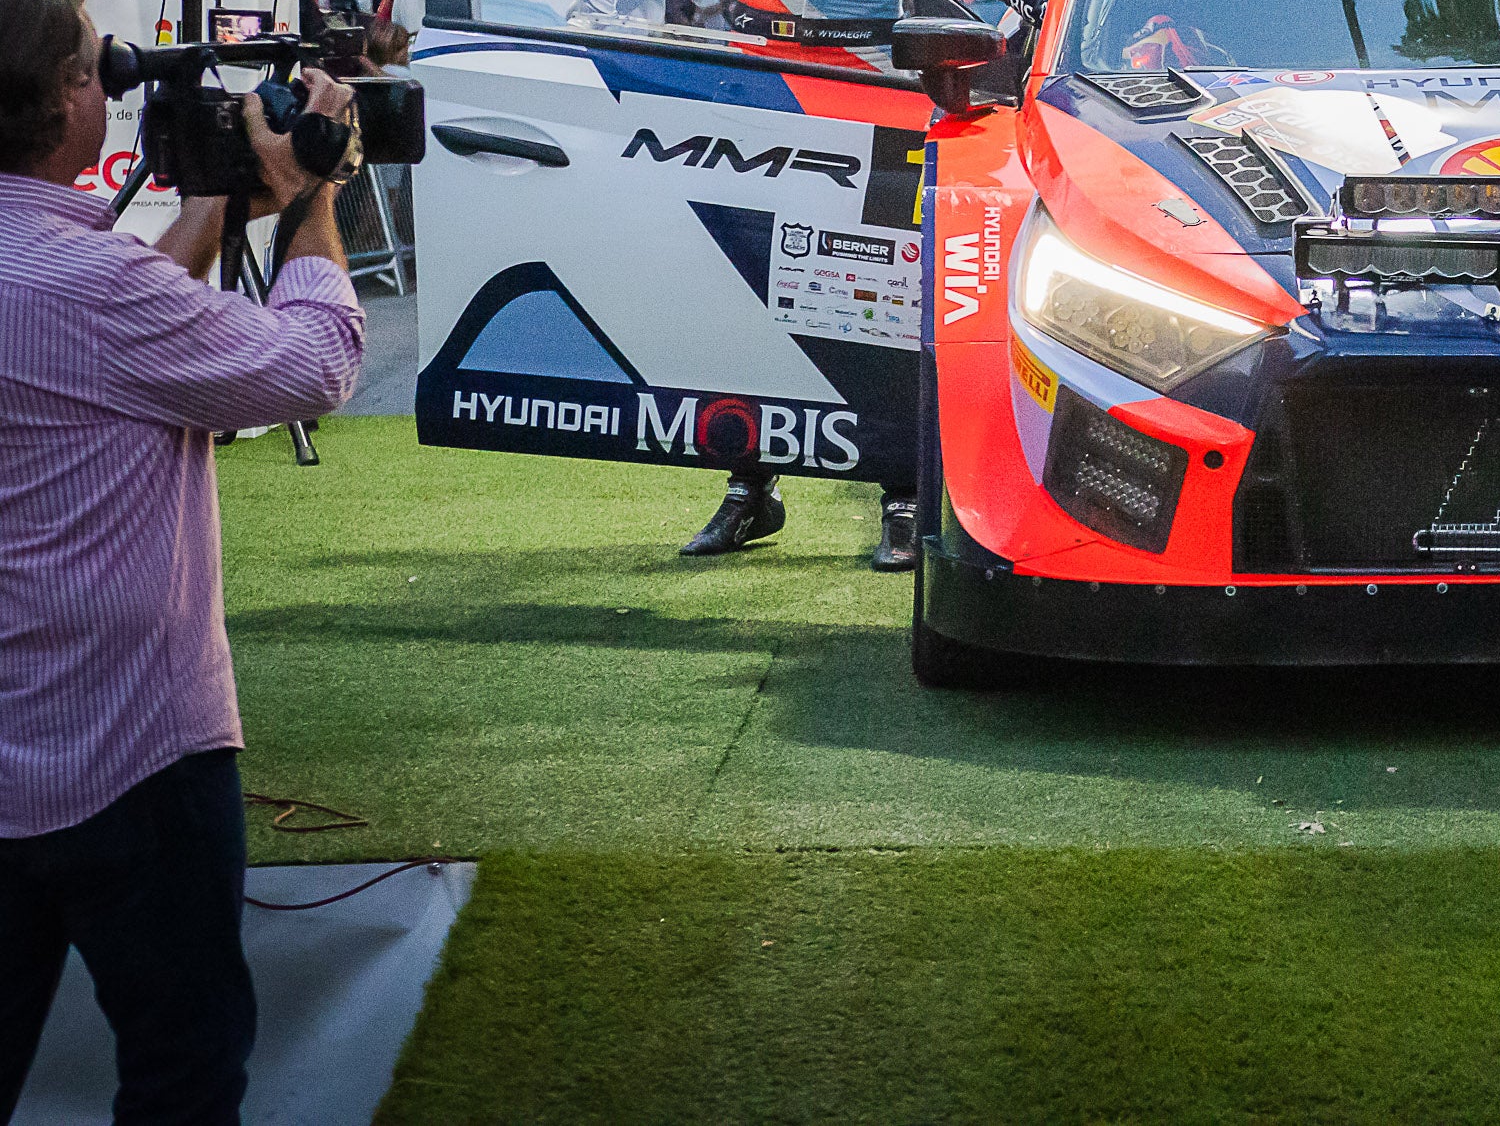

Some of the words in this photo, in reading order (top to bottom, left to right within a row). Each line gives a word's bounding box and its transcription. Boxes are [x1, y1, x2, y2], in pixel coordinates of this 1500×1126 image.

[620, 128, 861, 188] MMR
[832, 239, 889, 256] BERNER
[984, 206, 1001, 281] HYUNDAI
[888, 277, 909, 288] genil
[452, 389, 621, 435] HYUNDAI
[637, 392, 862, 472] MOBIS
